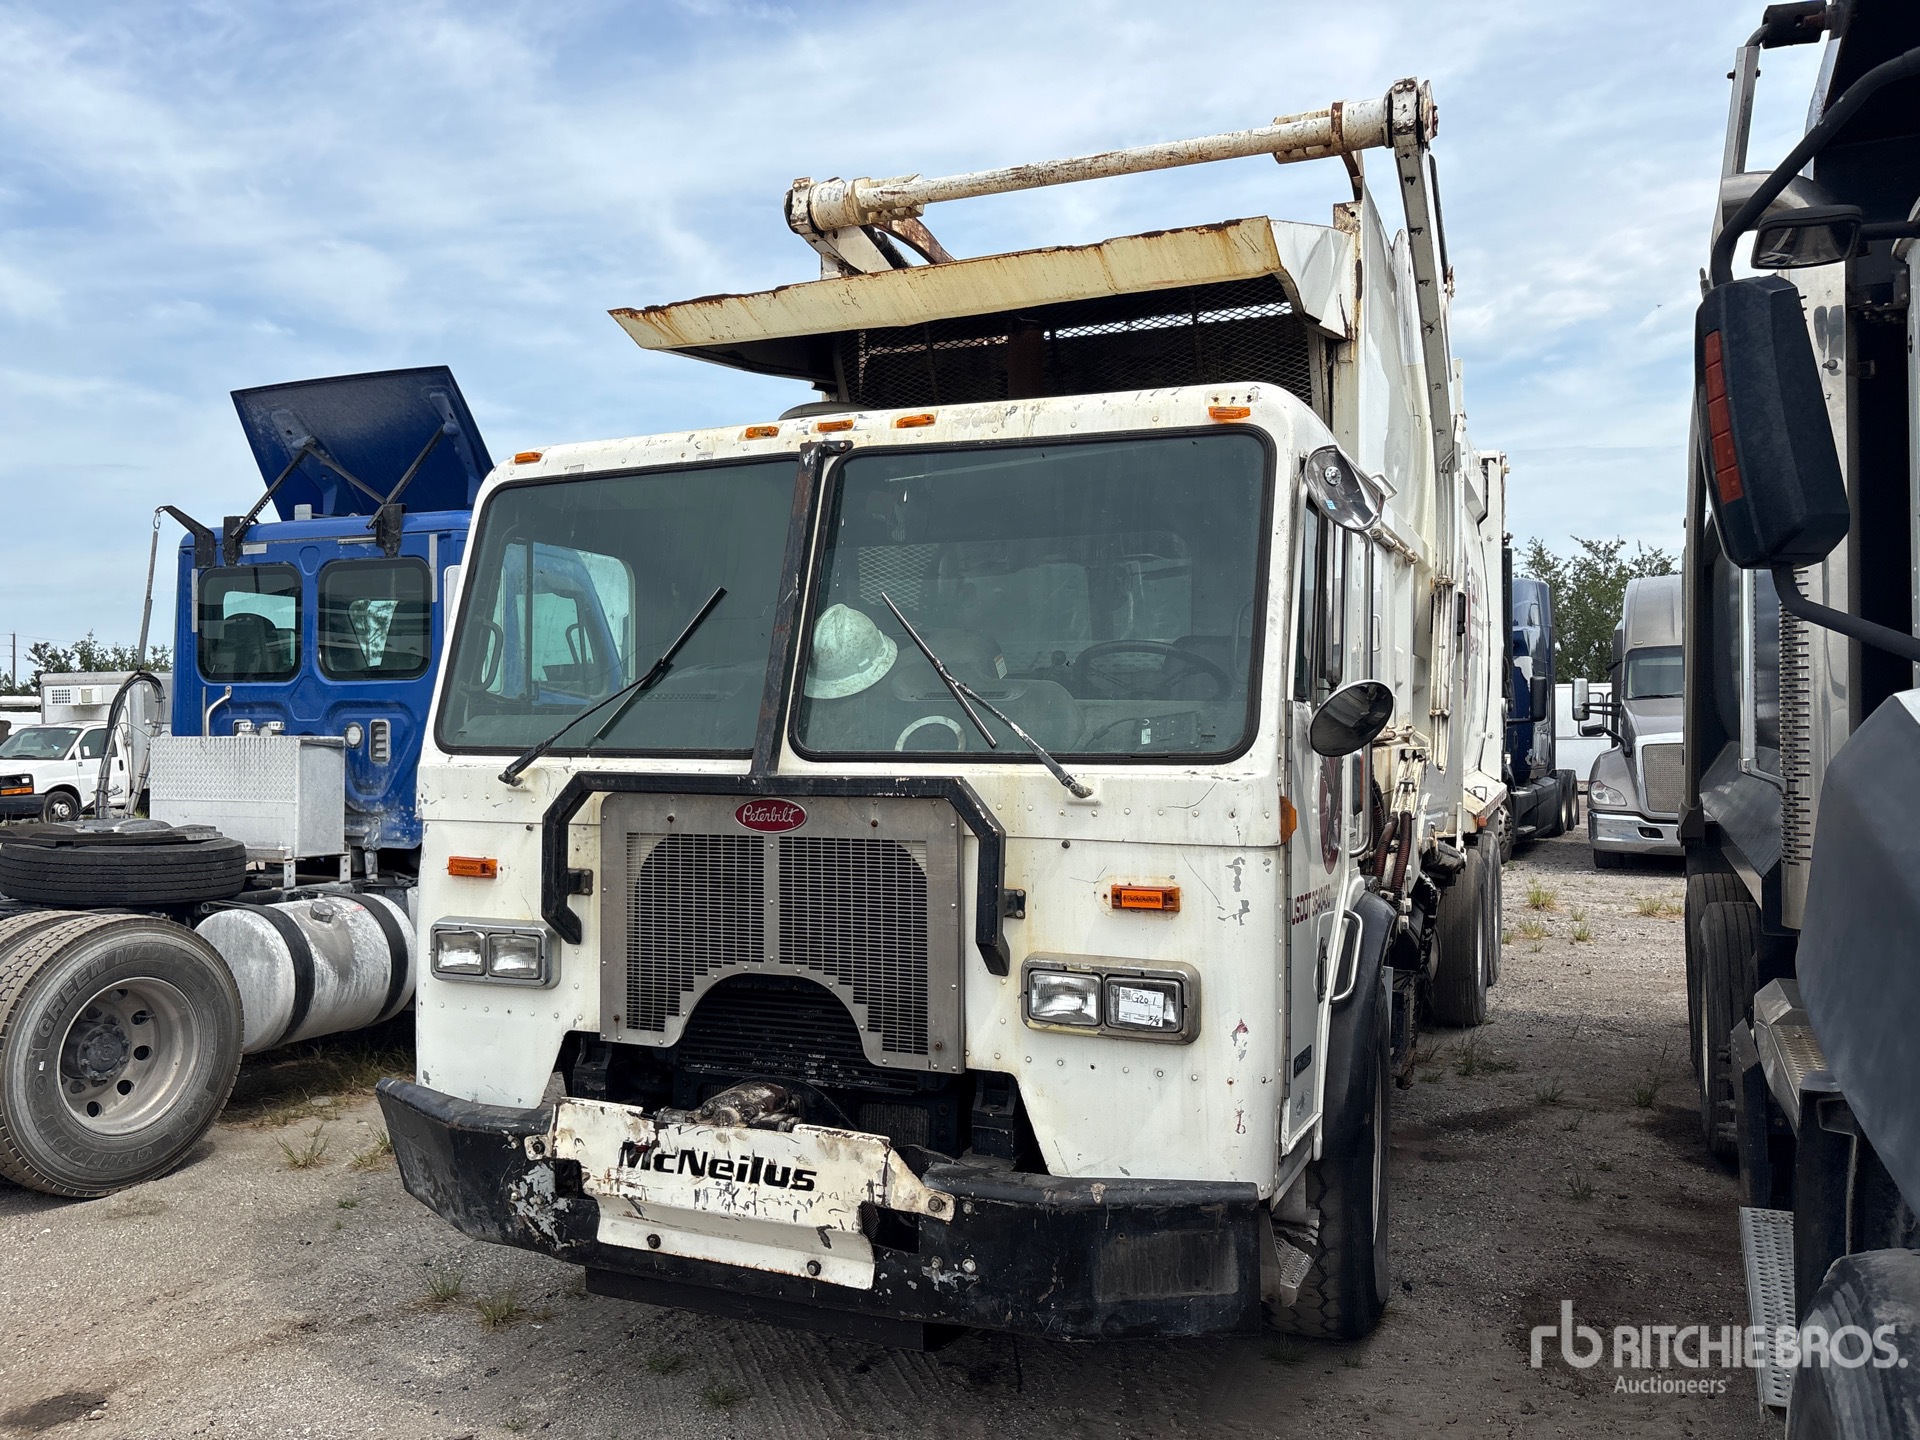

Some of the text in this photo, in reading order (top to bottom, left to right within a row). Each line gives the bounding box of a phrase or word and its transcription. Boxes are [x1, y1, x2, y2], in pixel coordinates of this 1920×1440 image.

[742, 804, 799, 827] Peterbilt
[39, 955, 106, 1038] GREEN
[618, 1141, 817, 1192] McNeilus
